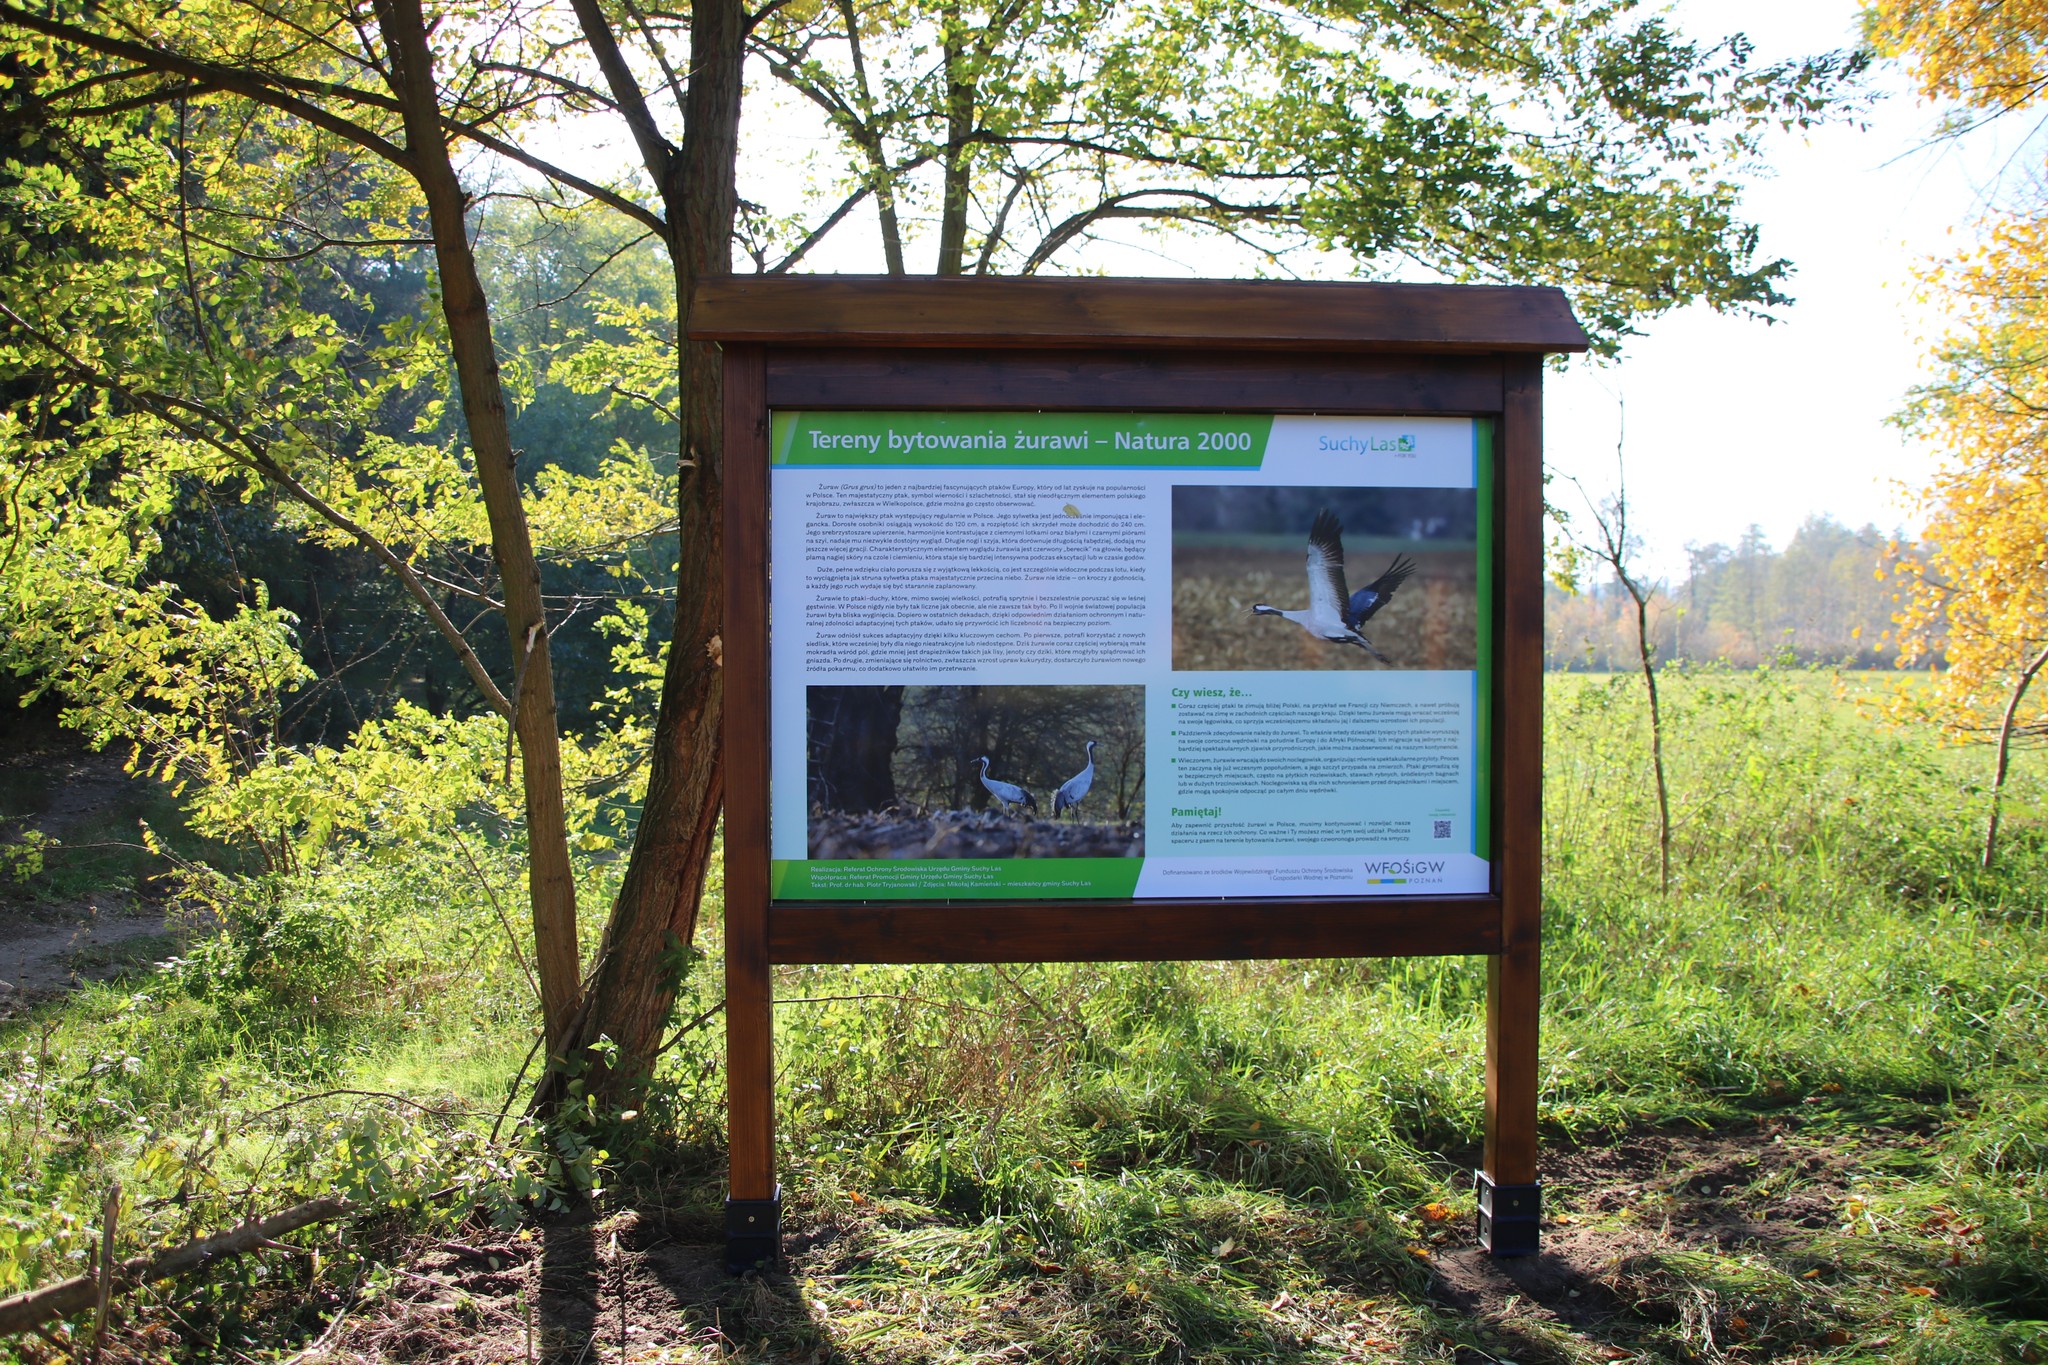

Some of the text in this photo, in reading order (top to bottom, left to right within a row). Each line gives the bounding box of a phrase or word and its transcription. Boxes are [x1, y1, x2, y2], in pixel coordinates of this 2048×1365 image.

[809, 430, 881, 454] Tereny
[888, 429, 1007, 454] bytowania
[1014, 430, 1089, 450] żurawi
[1116, 431, 1190, 450] Natura
[1197, 431, 1252, 451] 2000
[988, 484, 1011, 492] ptaków
[1171, 687, 1191, 700] Czy
[1193, 687, 1226, 699] wiesz,
[1171, 806, 1223, 819] Pamiętaj!
